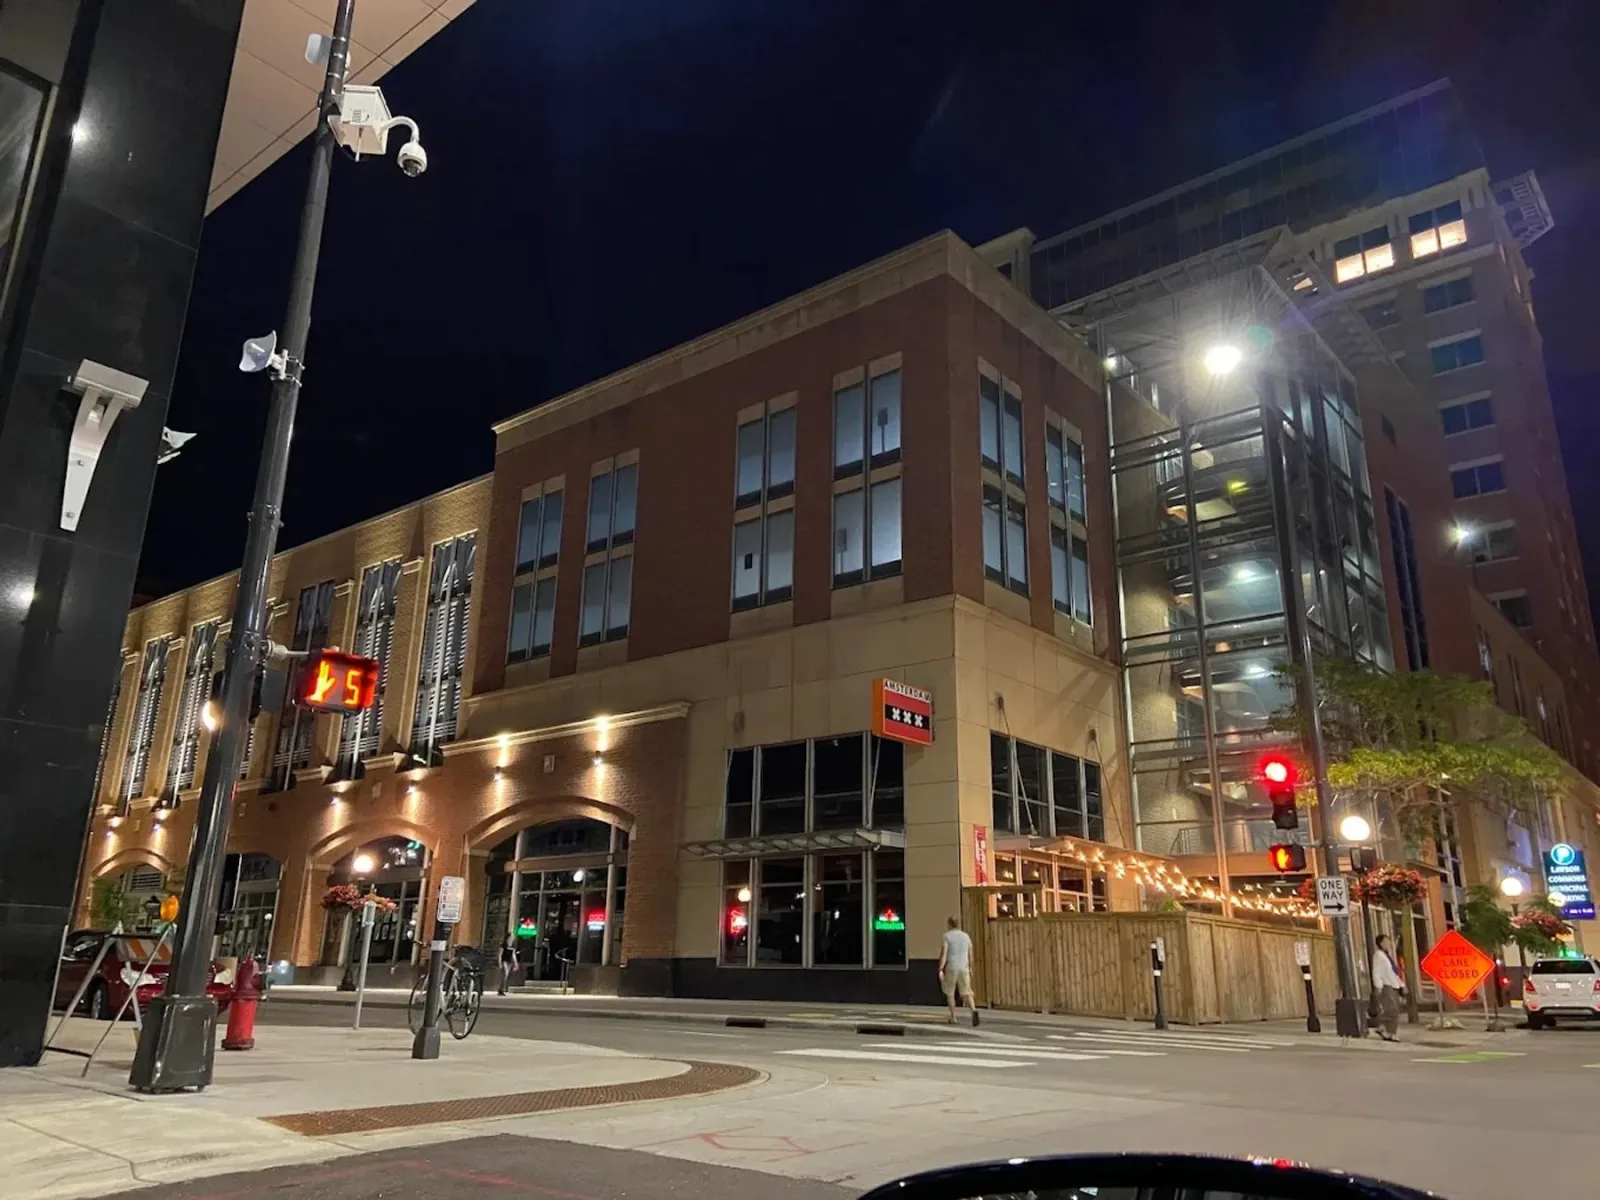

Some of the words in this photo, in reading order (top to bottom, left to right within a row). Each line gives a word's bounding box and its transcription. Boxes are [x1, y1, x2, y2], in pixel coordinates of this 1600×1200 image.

[344, 669, 361, 704] 5
[884, 680, 931, 700] AMSTERDAM
[1320, 880, 1342, 889] ONE
[1322, 891, 1343, 900] WAY
[1443, 958, 1470, 967] LANE
[1438, 969, 1479, 979] CLOSED
